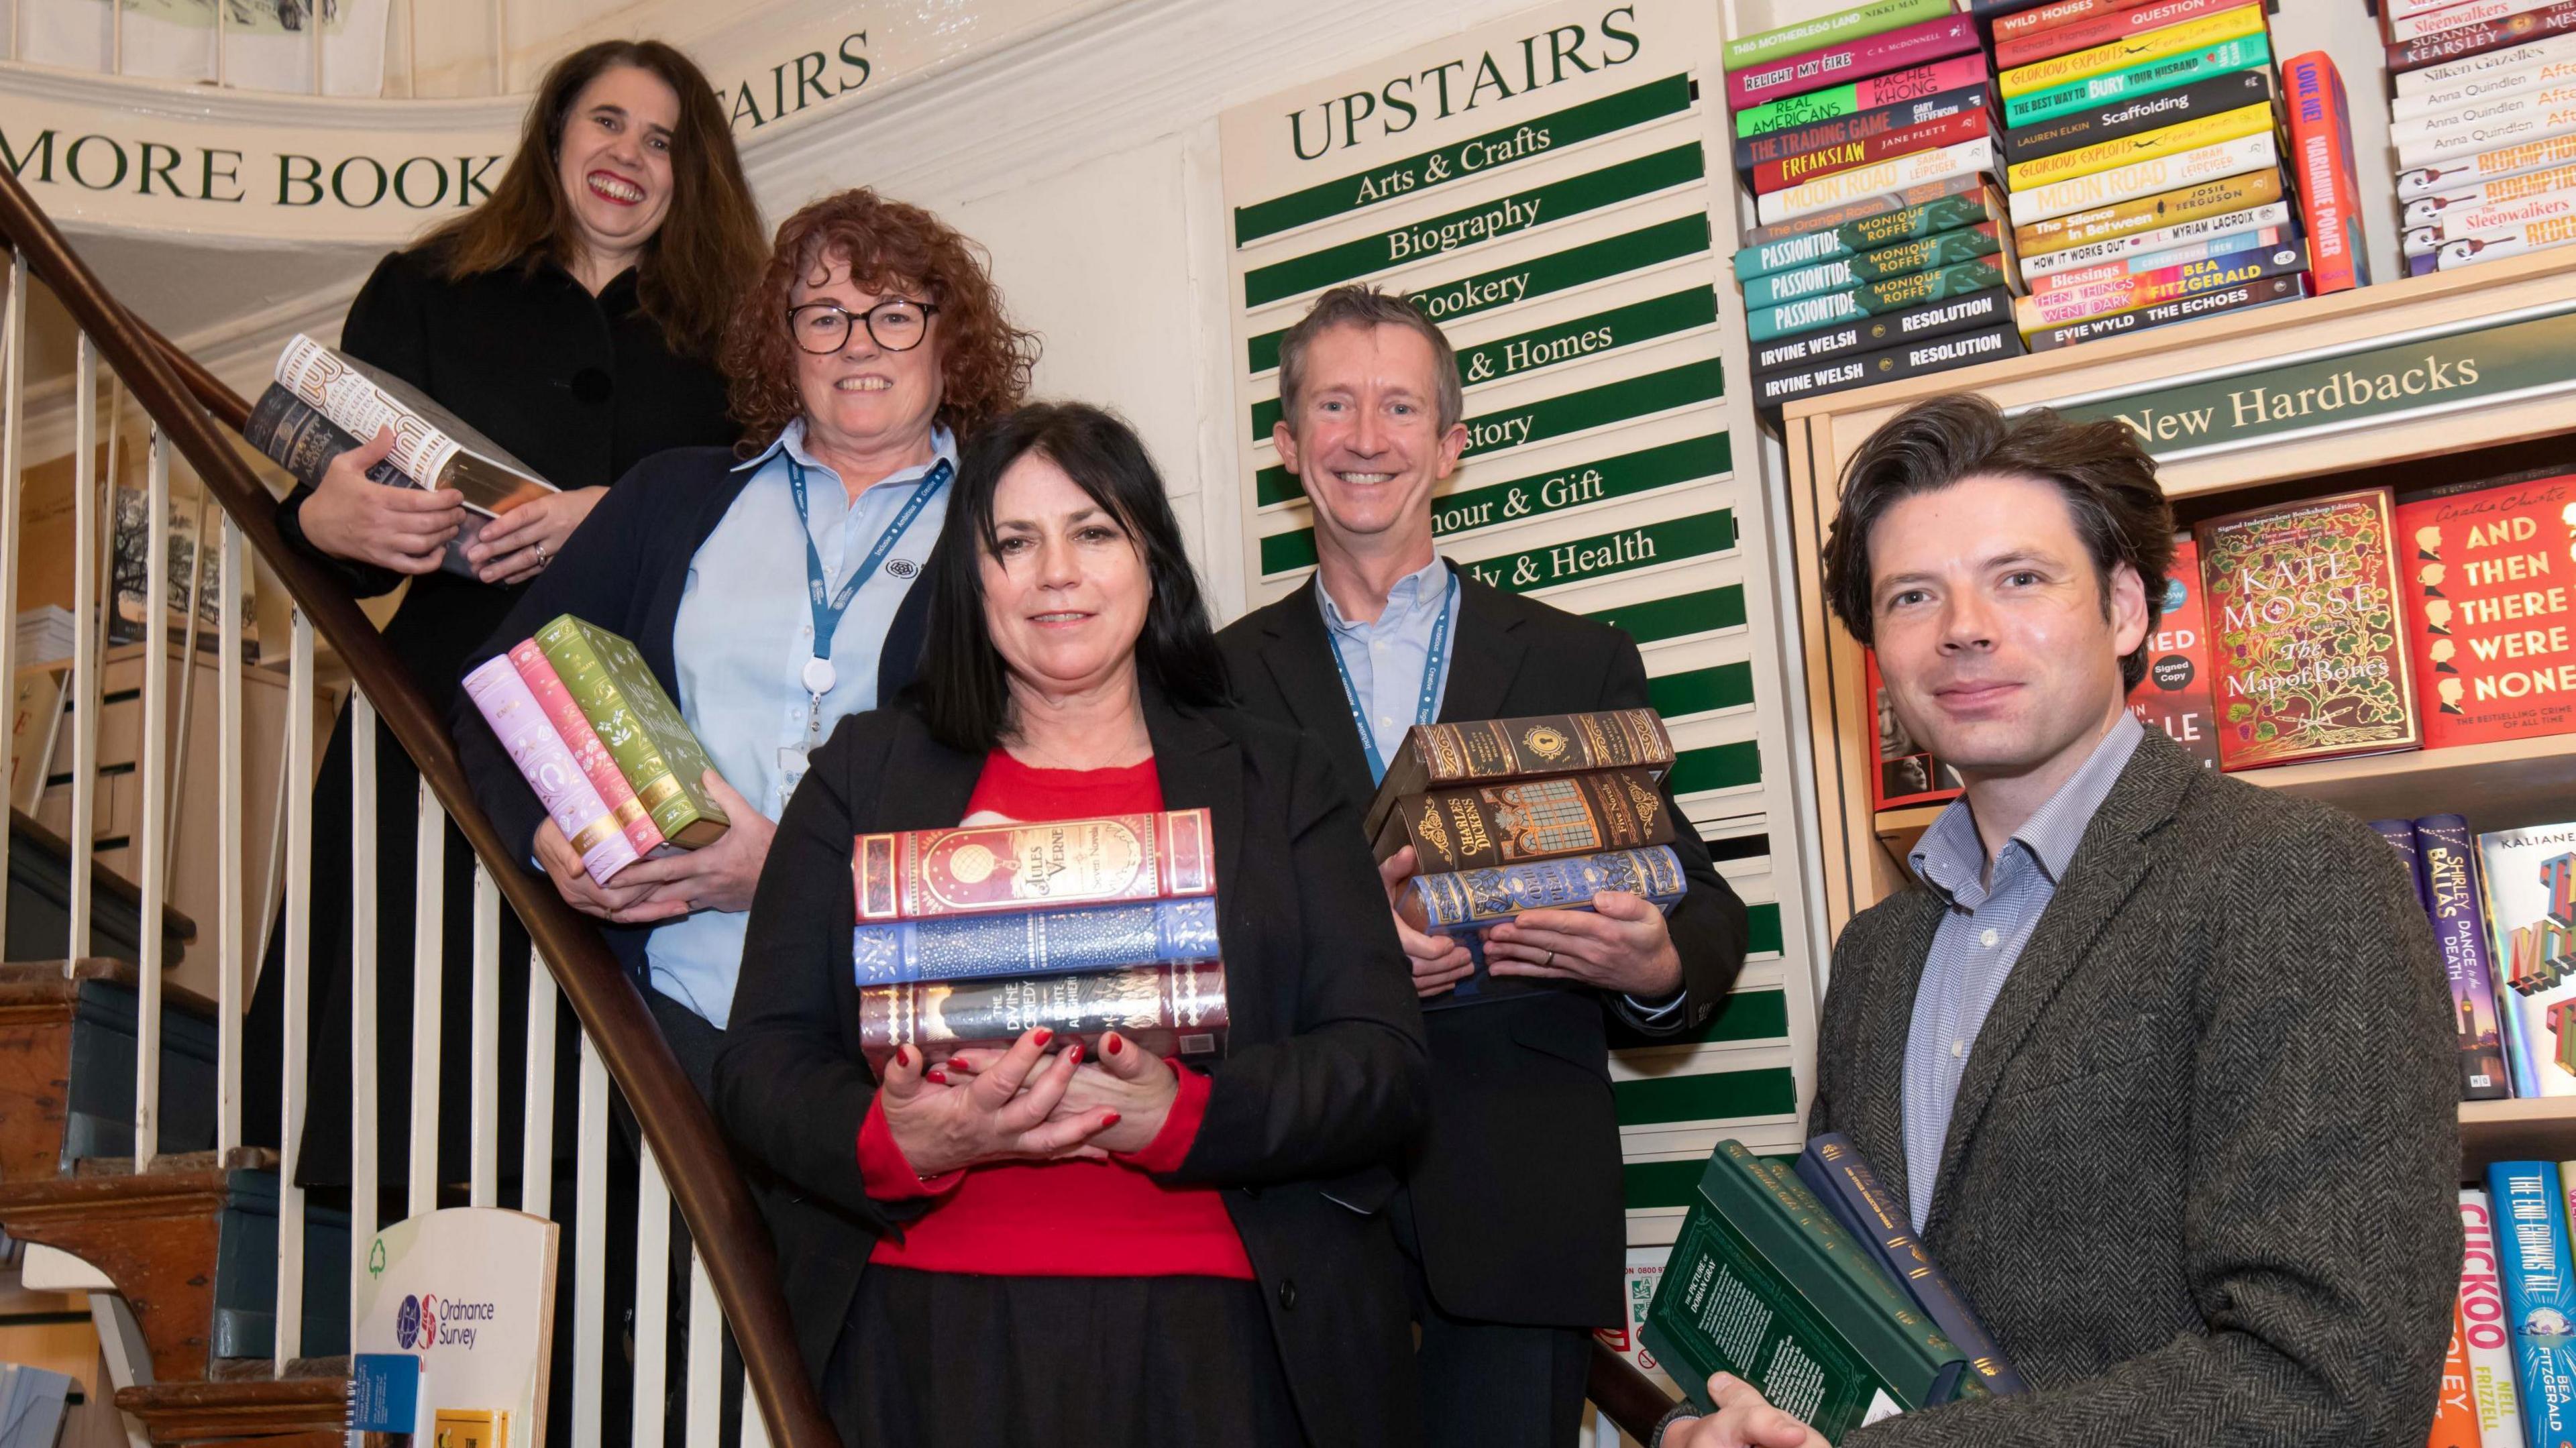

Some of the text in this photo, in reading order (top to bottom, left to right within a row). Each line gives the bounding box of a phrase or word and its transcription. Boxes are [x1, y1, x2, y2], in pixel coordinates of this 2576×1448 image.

[1833, 13, 1861, 28] LAND
[2004, 1, 2093, 30] WILD HOUSES
[2406, 30, 2498, 63] KEARSLEY
[2412, 23, 2489, 48] SUSANNA
[718, 30, 871, 129] AIRS
[1285, 4, 1640, 162] UPSTAIRS
[1744, 52, 1851, 91] RELIGHT MY FIRE
[1874, 66, 1935, 89] RACHEL
[2013, 58, 2198, 115] THE BEST WAY TO BURY YOUR HUSBAND
[2295, 63, 2319, 95] LOVE
[1776, 96, 1813, 113] REAL
[1874, 78, 1938, 105] KHONG
[2427, 74, 2526, 105] Anna Quindlen
[1752, 102, 1841, 134] AMERICANS
[2101, 94, 2189, 126] Scaffolding
[2425, 99, 2524, 130] Anna Quindlen
[1750, 111, 1892, 161] THE TRADING GAME
[1882, 125, 1947, 149] JANE FLETT
[2017, 121, 2090, 148] LAUREN ELKIN
[1355, 127, 1552, 205] Arts & Crafts
[1782, 141, 1865, 180] FREAKSLAW
[272, 154, 504, 209] BOOK
[1782, 164, 1898, 211] MOON ROAD
[2191, 184, 2225, 198] JOSIE
[2305, 135, 2342, 259] MARIANNE POWER
[2176, 189, 2243, 211] FERGUSON
[1387, 197, 1542, 261] Biography
[1768, 202, 1884, 237] The Orange Room
[1858, 207, 1926, 232] MONIQUE
[1867, 221, 1917, 241] ROFFEY
[2035, 209, 2116, 235] The Silence
[2068, 213, 2153, 241] In Between
[2172, 211, 2255, 239] MYRIAM LACROIX
[1761, 229, 1841, 270] PASSIONTIDE
[1870, 239, 1938, 264] MONIQUE
[1879, 253, 1930, 273] ROFFEY
[2033, 239, 2125, 270] HOW IT WORKS OUT
[1771, 260, 1851, 300] PASSIONTIDE
[1873, 270, 1943, 294] MONIQUE
[2050, 263, 2120, 288] Blessings
[2149, 264, 2262, 299] FITZGERALD
[2183, 260, 2219, 276] BEA
[1884, 284, 1935, 304] ROFFEY
[2033, 277, 2134, 307] THEN THINGS
[2043, 294, 2131, 323] WENT DARK
[2147, 288, 2249, 321] THE ECHOES
[1774, 291, 1856, 330] PASSIONTIDE
[1902, 297, 1992, 333] RESOLUTION
[2054, 315, 2135, 342] EVIE WYLD
[1468, 327, 1613, 382] & Homes
[1760, 330, 1857, 366] IRVINE WELSH
[1910, 334, 2002, 366] RESOLUTION
[1765, 363, 1864, 397] IRVINE WELSH
[2114, 355, 2479, 443] New Hardbacks
[1466, 414, 1534, 451] story
[1503, 470, 1605, 518] & Gift
[2218, 502, 2361, 533] Signed Independent Bookshop Edition
[2467, 516, 2537, 549] AND
[875, 536, 893, 556] Inclusive
[1512, 531, 1656, 585] & Health
[2241, 552, 2353, 596] KATE
[2462, 551, 2551, 587] THEN
[2223, 582, 2378, 633] MOSSE
[2459, 588, 2569, 626] THERE
[2281, 640, 2322, 661] The
[2469, 626, 2570, 663] WERE
[2155, 661, 2189, 673] Signed
[2161, 672, 2186, 682] Copy
[2228, 659, 2390, 699] Map of Bones
[2474, 667, 2576, 702] NONE
[2477, 710, 2537, 723] BESTSELLING
[2541, 706, 2573, 715] CRIME
[1462, 798, 1491, 851] DICKENS
[1603, 784, 1626, 834] Five Novels
[1448, 798, 1477, 856] CHARLES
[1026, 828, 1066, 895] JULES VERNE
[2426, 847, 2456, 920] BALLAS
[2447, 856, 2471, 910] SHIRLEY
[2444, 936, 2462, 981] DEATH
[2458, 920, 2477, 967] DANCE
[2510, 1175, 2558, 1293] THE END CROWNS ALL
[1688, 1260, 1706, 1295] PICTURE
[1690, 1259, 1716, 1314] DORIAN GRAY
[2459, 1203, 2506, 1349] CUCKOO
[439, 1298, 494, 1321] Ordnance
[438, 1322, 477, 1350] Survey
[2474, 1366, 2499, 1431] FRIZZELL
[2496, 1380, 2516, 1416] NELL
[2539, 1347, 2562, 1431] FITZGERALD
[2557, 1375, 2571, 1404] BEA
